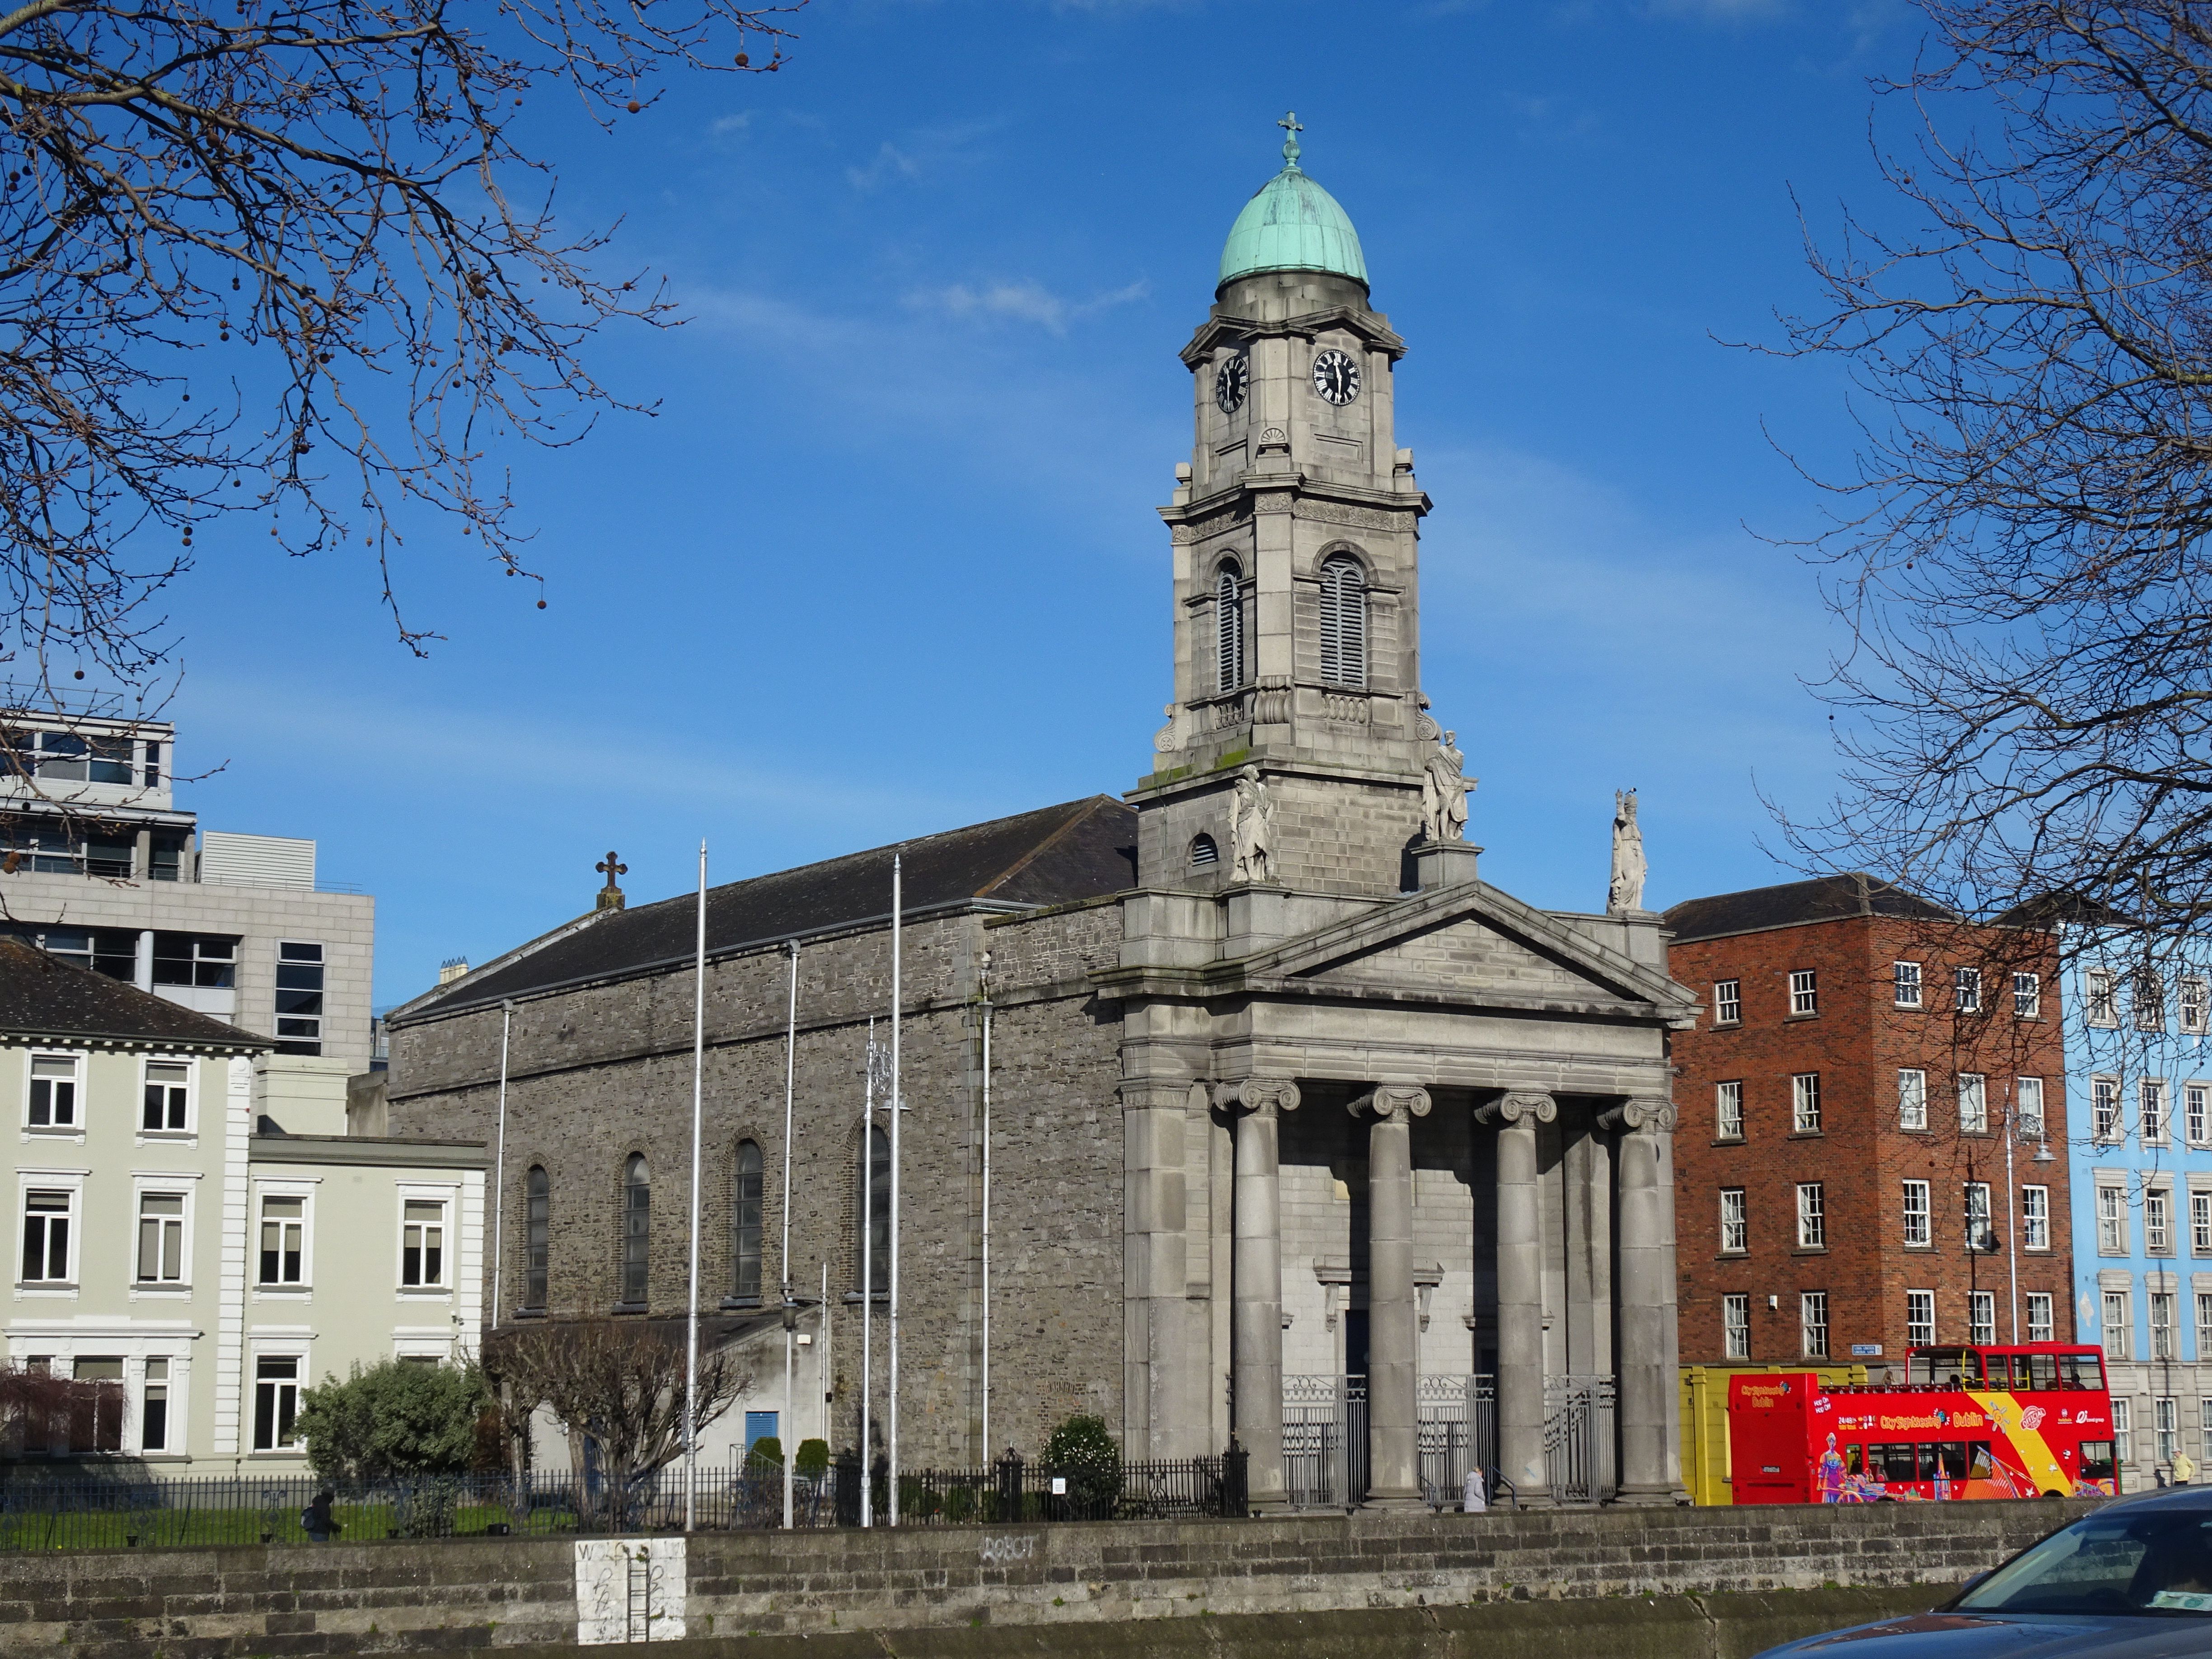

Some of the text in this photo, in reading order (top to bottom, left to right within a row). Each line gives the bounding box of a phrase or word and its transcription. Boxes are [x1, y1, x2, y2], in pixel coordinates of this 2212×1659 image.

[1343, 357, 1349, 366] I
[1752, 1397, 1774, 1407] Dublin
[1953, 1411, 1983, 1428] Dublin
[2022, 1409, 2044, 1428] OFFICIAL
